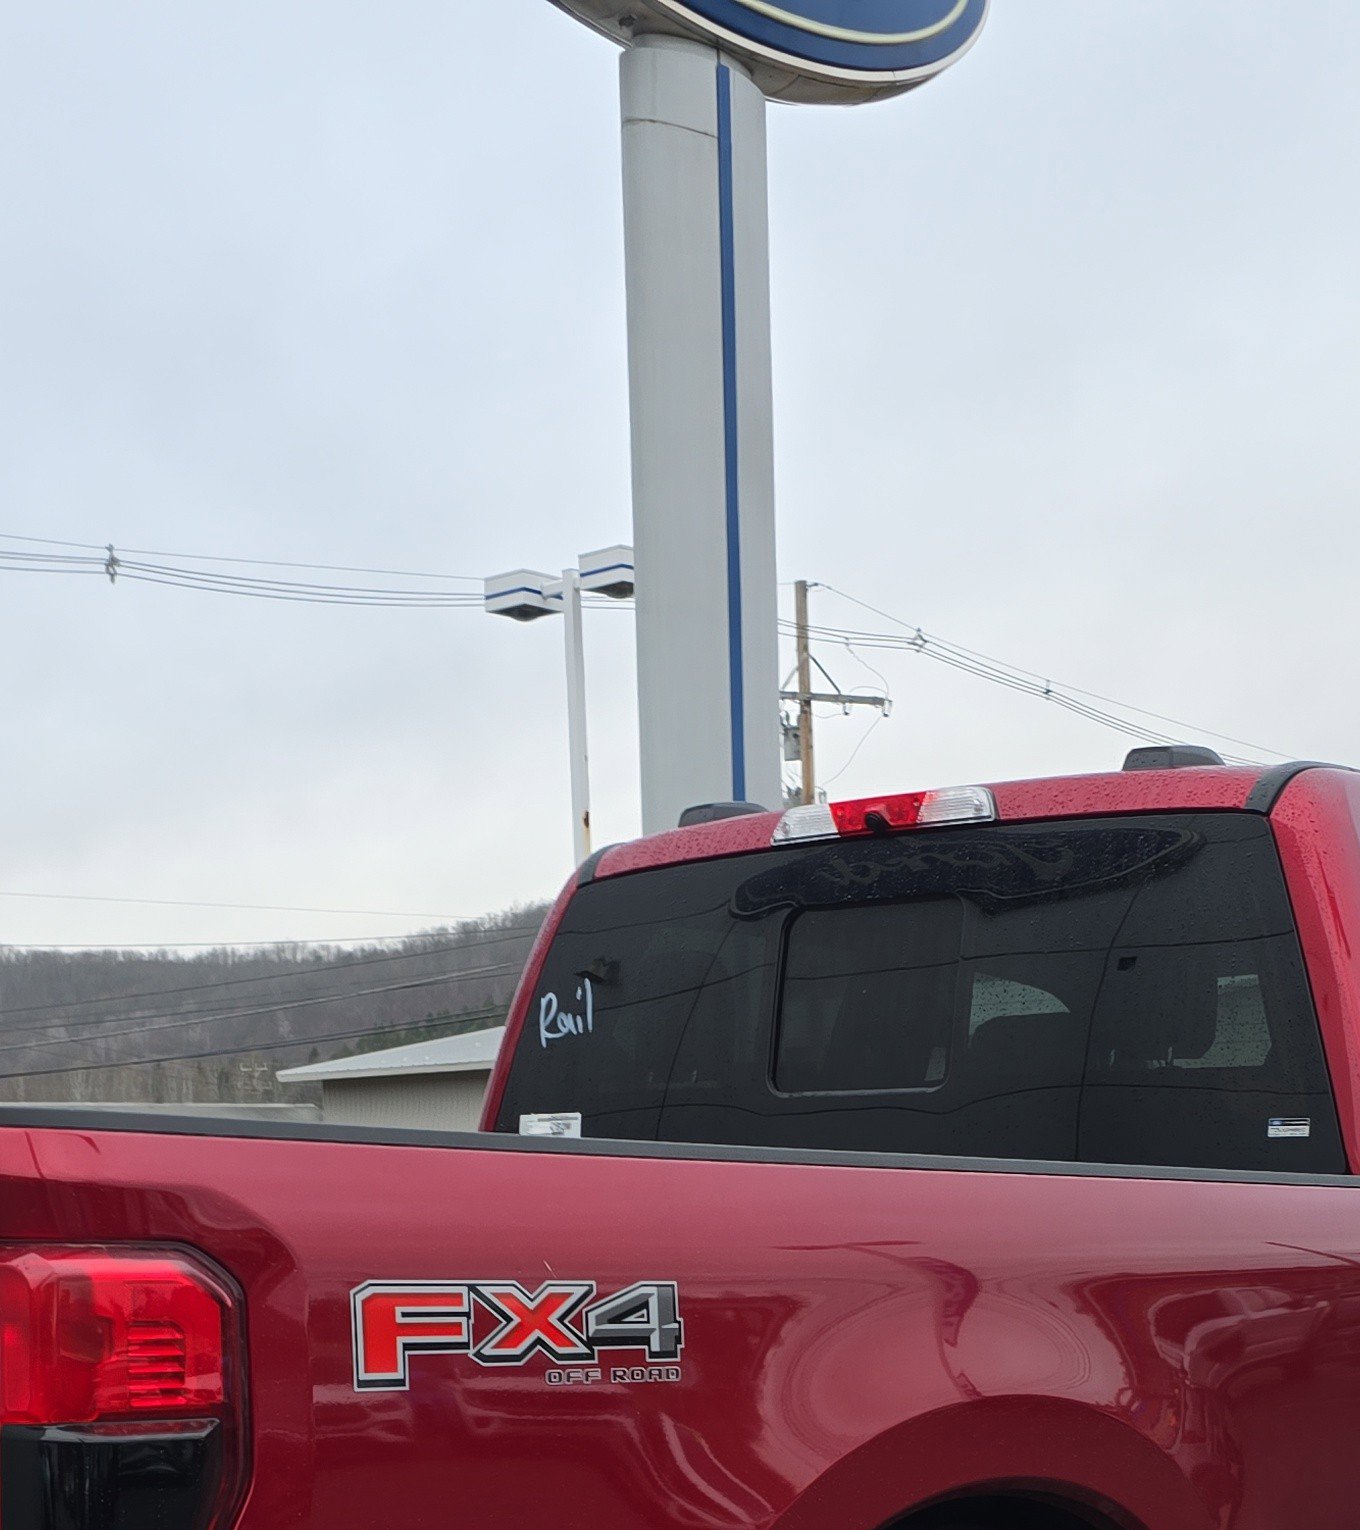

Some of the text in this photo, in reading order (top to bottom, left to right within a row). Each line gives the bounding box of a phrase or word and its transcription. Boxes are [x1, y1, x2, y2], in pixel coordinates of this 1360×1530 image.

[350, 1279, 685, 1393] FX4
[545, 1366, 682, 1386] OFF ROAD
